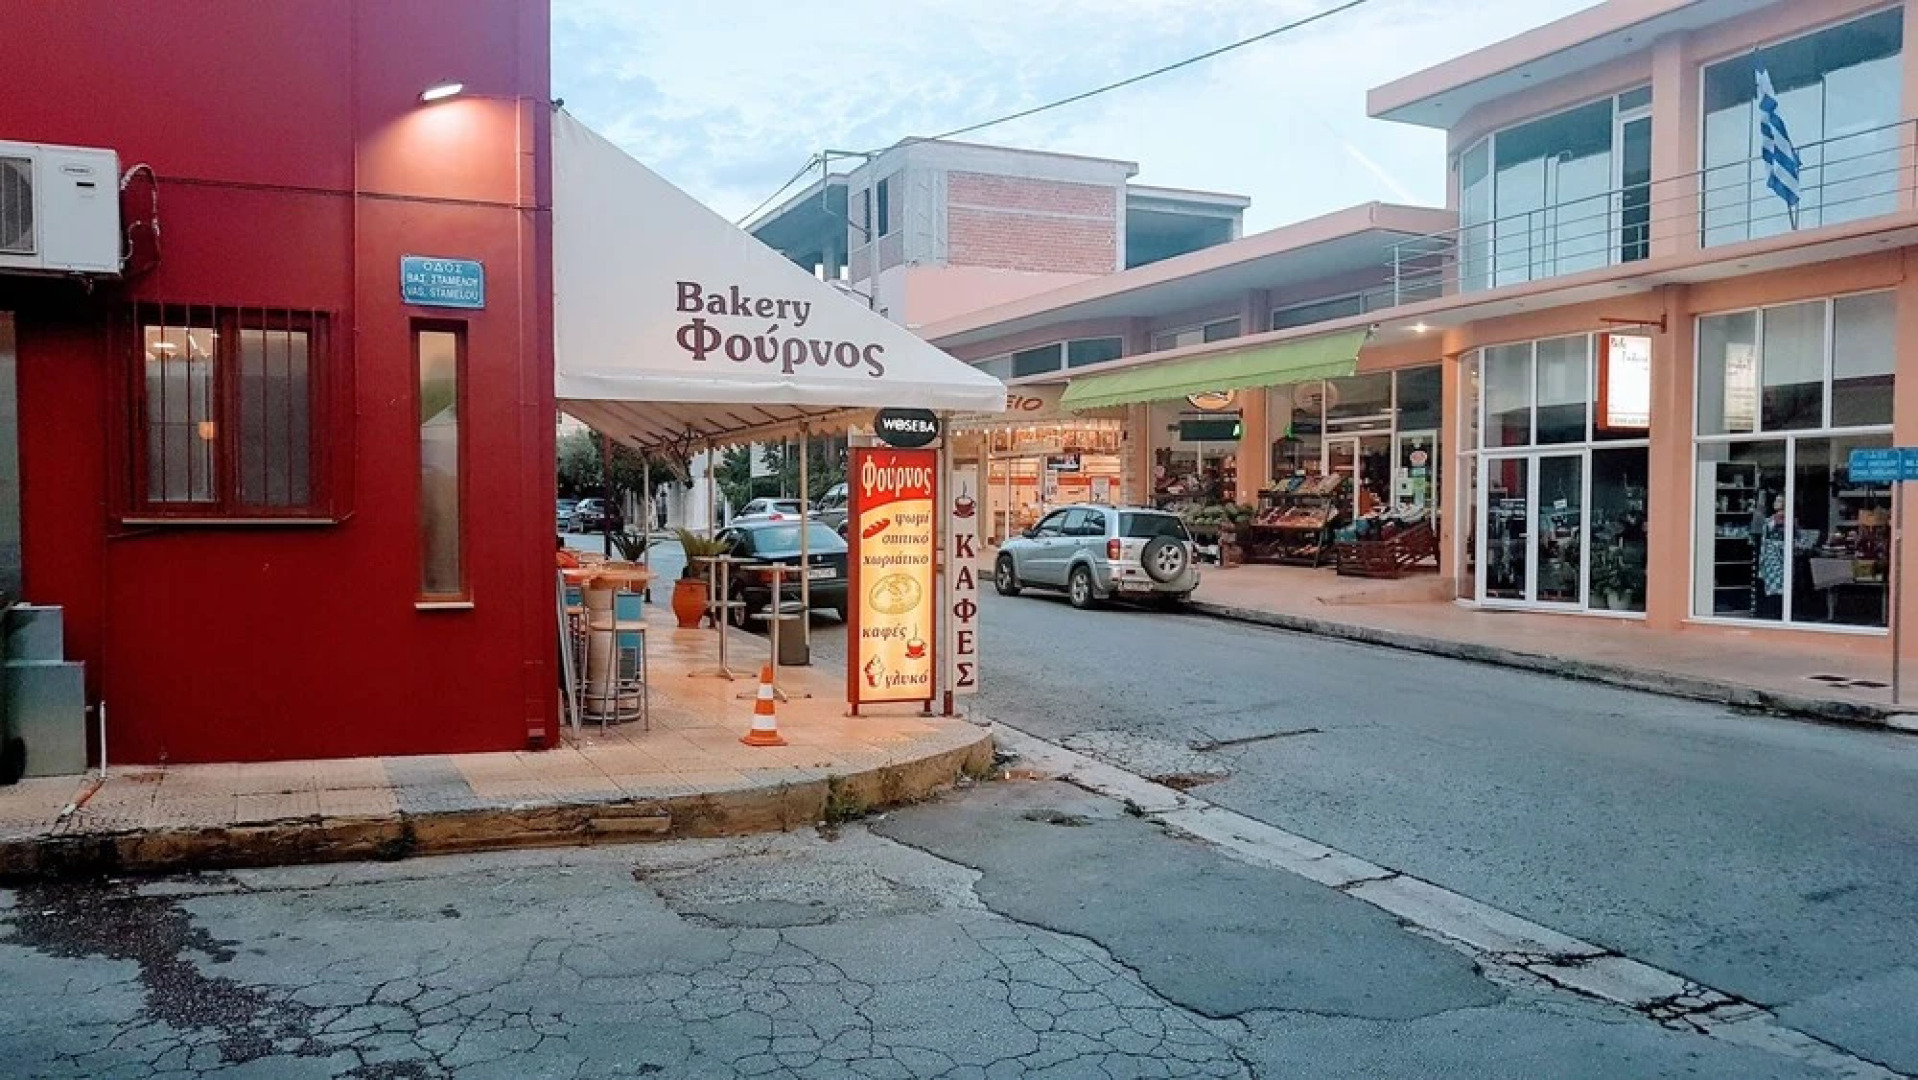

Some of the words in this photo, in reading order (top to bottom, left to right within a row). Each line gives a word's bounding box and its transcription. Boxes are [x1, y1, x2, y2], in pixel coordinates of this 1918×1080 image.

[423, 261, 463, 274] ΟΔΟΣ
[676, 281, 812, 327] Bakery
[676, 317, 885, 378] Φούρνος
[882, 417, 935, 433] WOSEBA
[862, 454, 932, 498] Φούρνος
[895, 510, 930, 527] ψωμί
[881, 531, 930, 545] σπιτικό
[862, 550, 930, 568] χωριάτικο
[953, 534, 978, 688] ΚΑΦΕΣ
[862, 622, 908, 641] καφές
[885, 669, 929, 689] γλυκό
